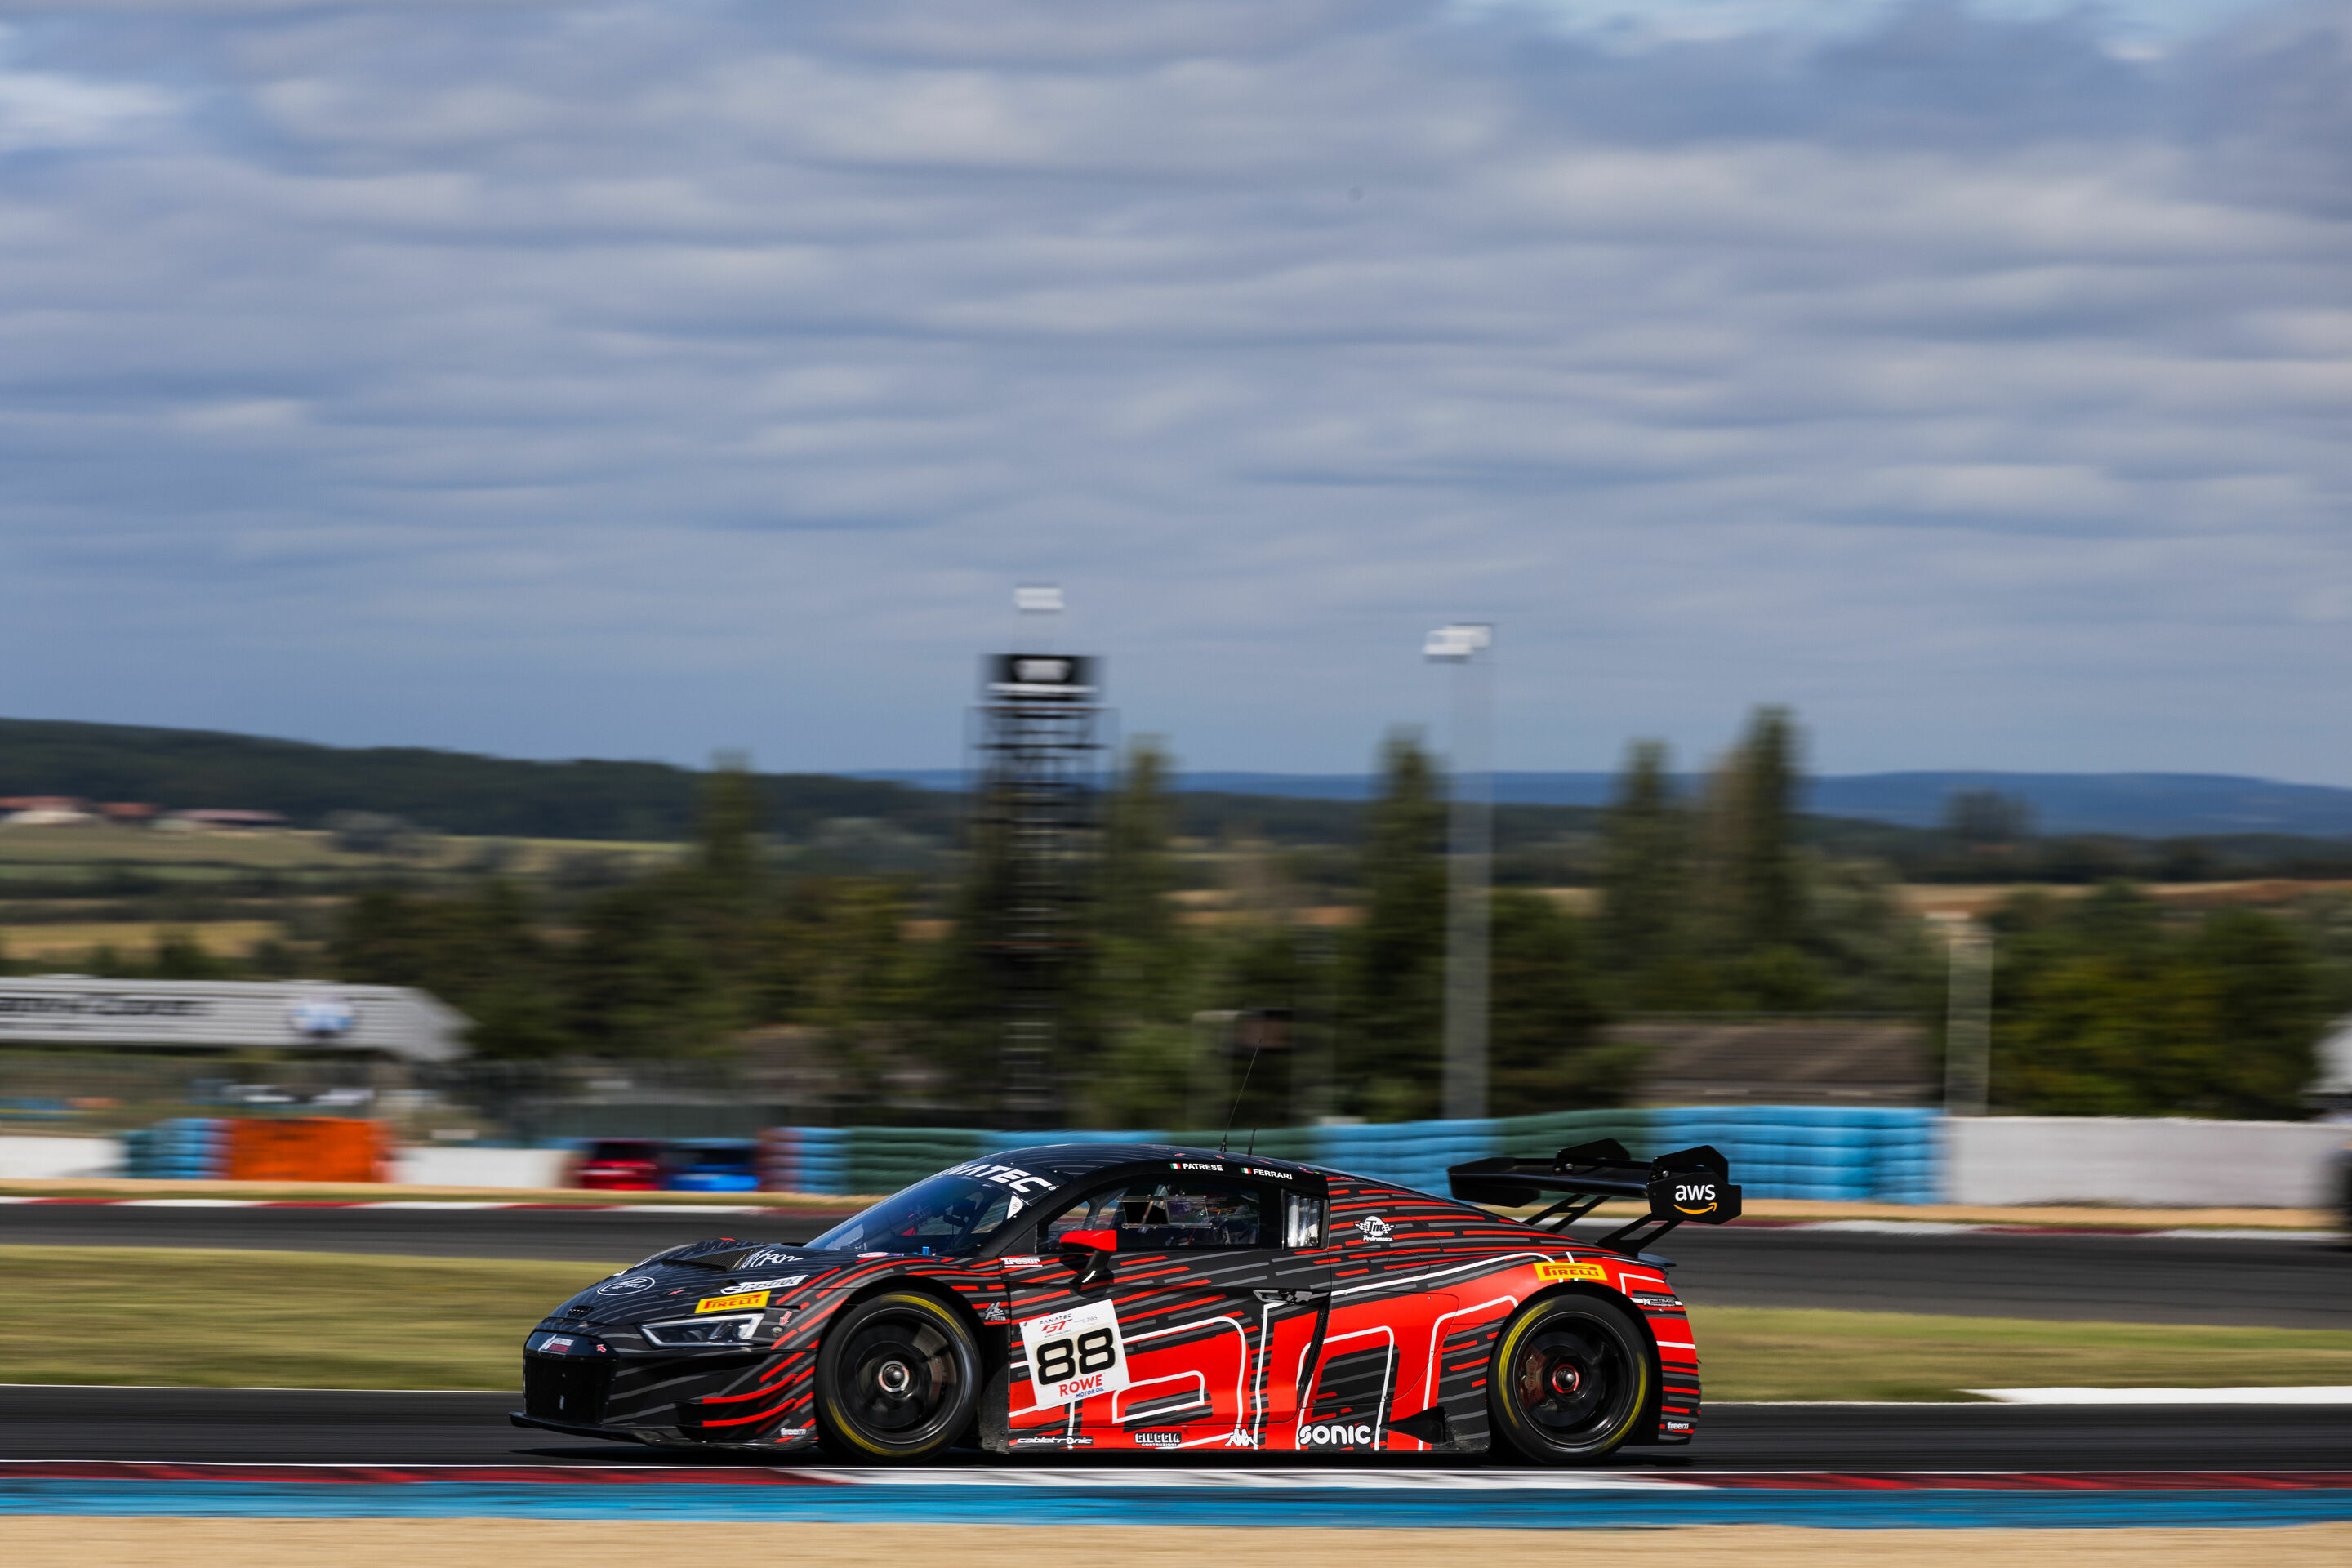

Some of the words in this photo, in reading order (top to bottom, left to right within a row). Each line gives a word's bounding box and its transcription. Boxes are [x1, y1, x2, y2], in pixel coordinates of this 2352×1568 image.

[1183, 1163, 1223, 1171] PATRESE
[1253, 1169, 1293, 1180] FERRARI
[1675, 1184, 1716, 1200] aws
[1542, 1265, 1599, 1276] PIRELLI
[703, 1294, 762, 1309] PIRELLI
[1040, 1313, 1072, 1325] FANATEC
[1041, 1318, 1073, 1334] GT
[1036, 1327, 1116, 1385] 88
[1058, 1374, 1103, 1397] ROWE
[1075, 1389, 1095, 1398] MOTOR
[1668, 1421, 1690, 1430] freem
